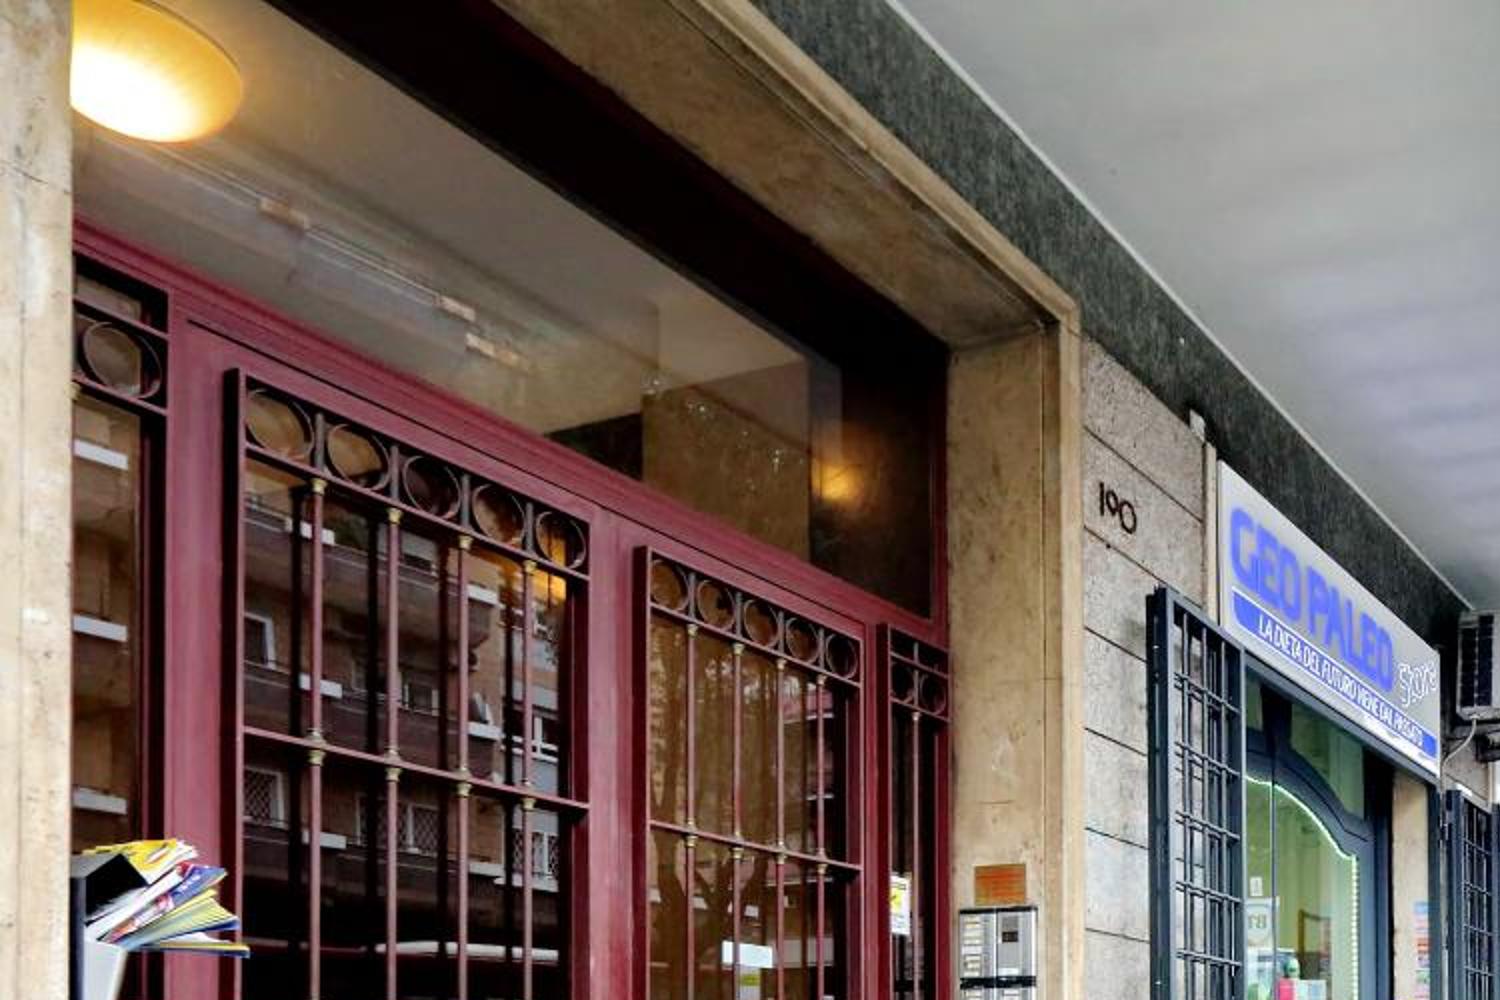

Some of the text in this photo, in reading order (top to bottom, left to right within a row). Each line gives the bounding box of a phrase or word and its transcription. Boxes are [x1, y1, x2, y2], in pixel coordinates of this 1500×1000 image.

[1099, 481, 1137, 534] 190
[1231, 507, 1393, 693] GEO PALEO
[1259, 613, 1273, 643] LA
[1303, 643, 1320, 677] DEL
